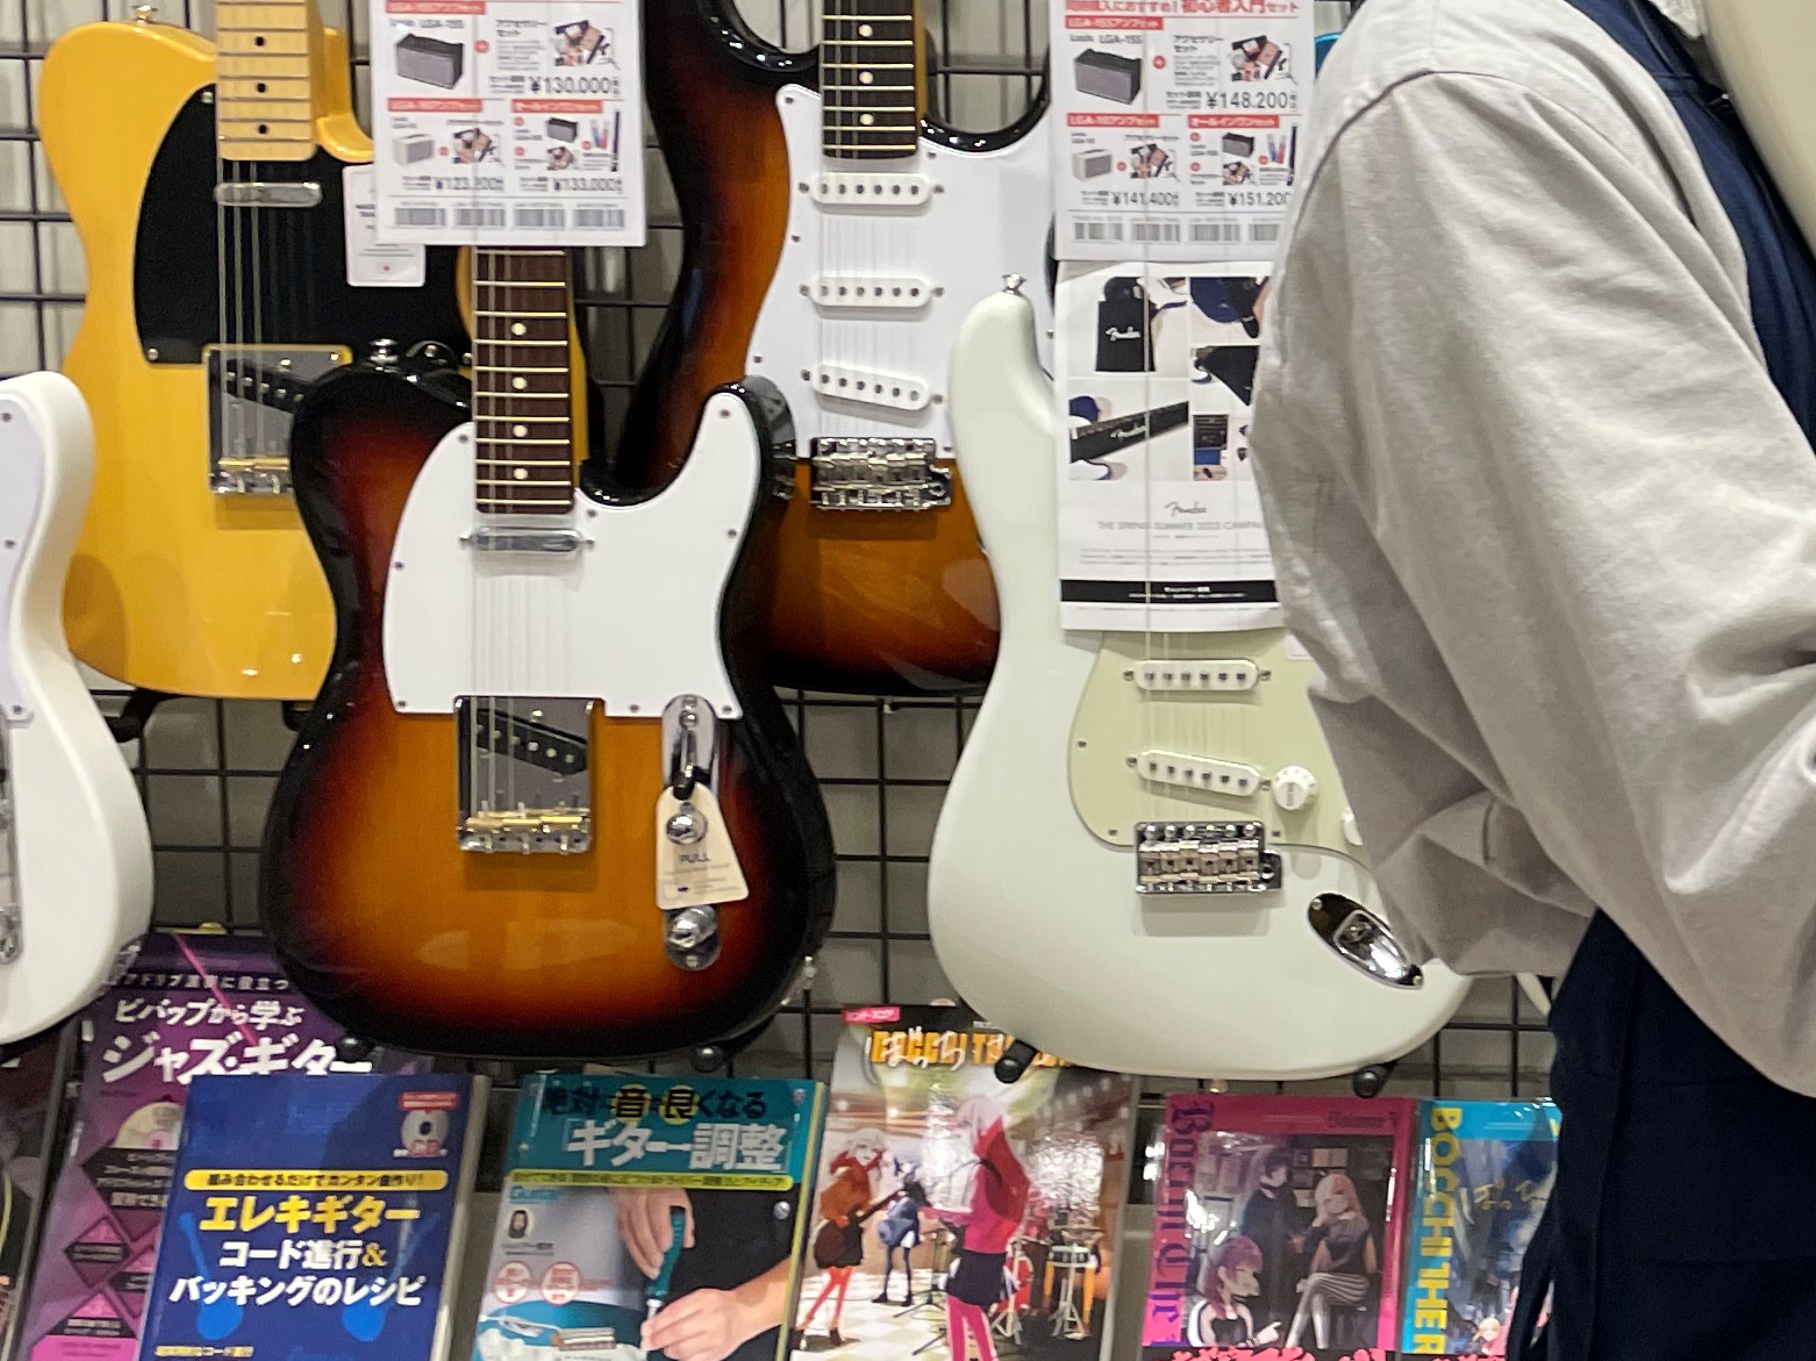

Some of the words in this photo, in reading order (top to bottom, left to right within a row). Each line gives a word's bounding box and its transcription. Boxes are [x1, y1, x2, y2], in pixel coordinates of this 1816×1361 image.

[1205, 90, 1290, 111] ¥148,200
[115, 997, 305, 1030] ビバップから学ぶ
[103, 1031, 373, 1084] ジャズ・ギター
[567, 1119, 788, 1171] ギター調整
[199, 1194, 421, 1234] エレキギター
[219, 1238, 388, 1270] コード進行&
[169, 1273, 427, 1307] バッキングのレシピ
